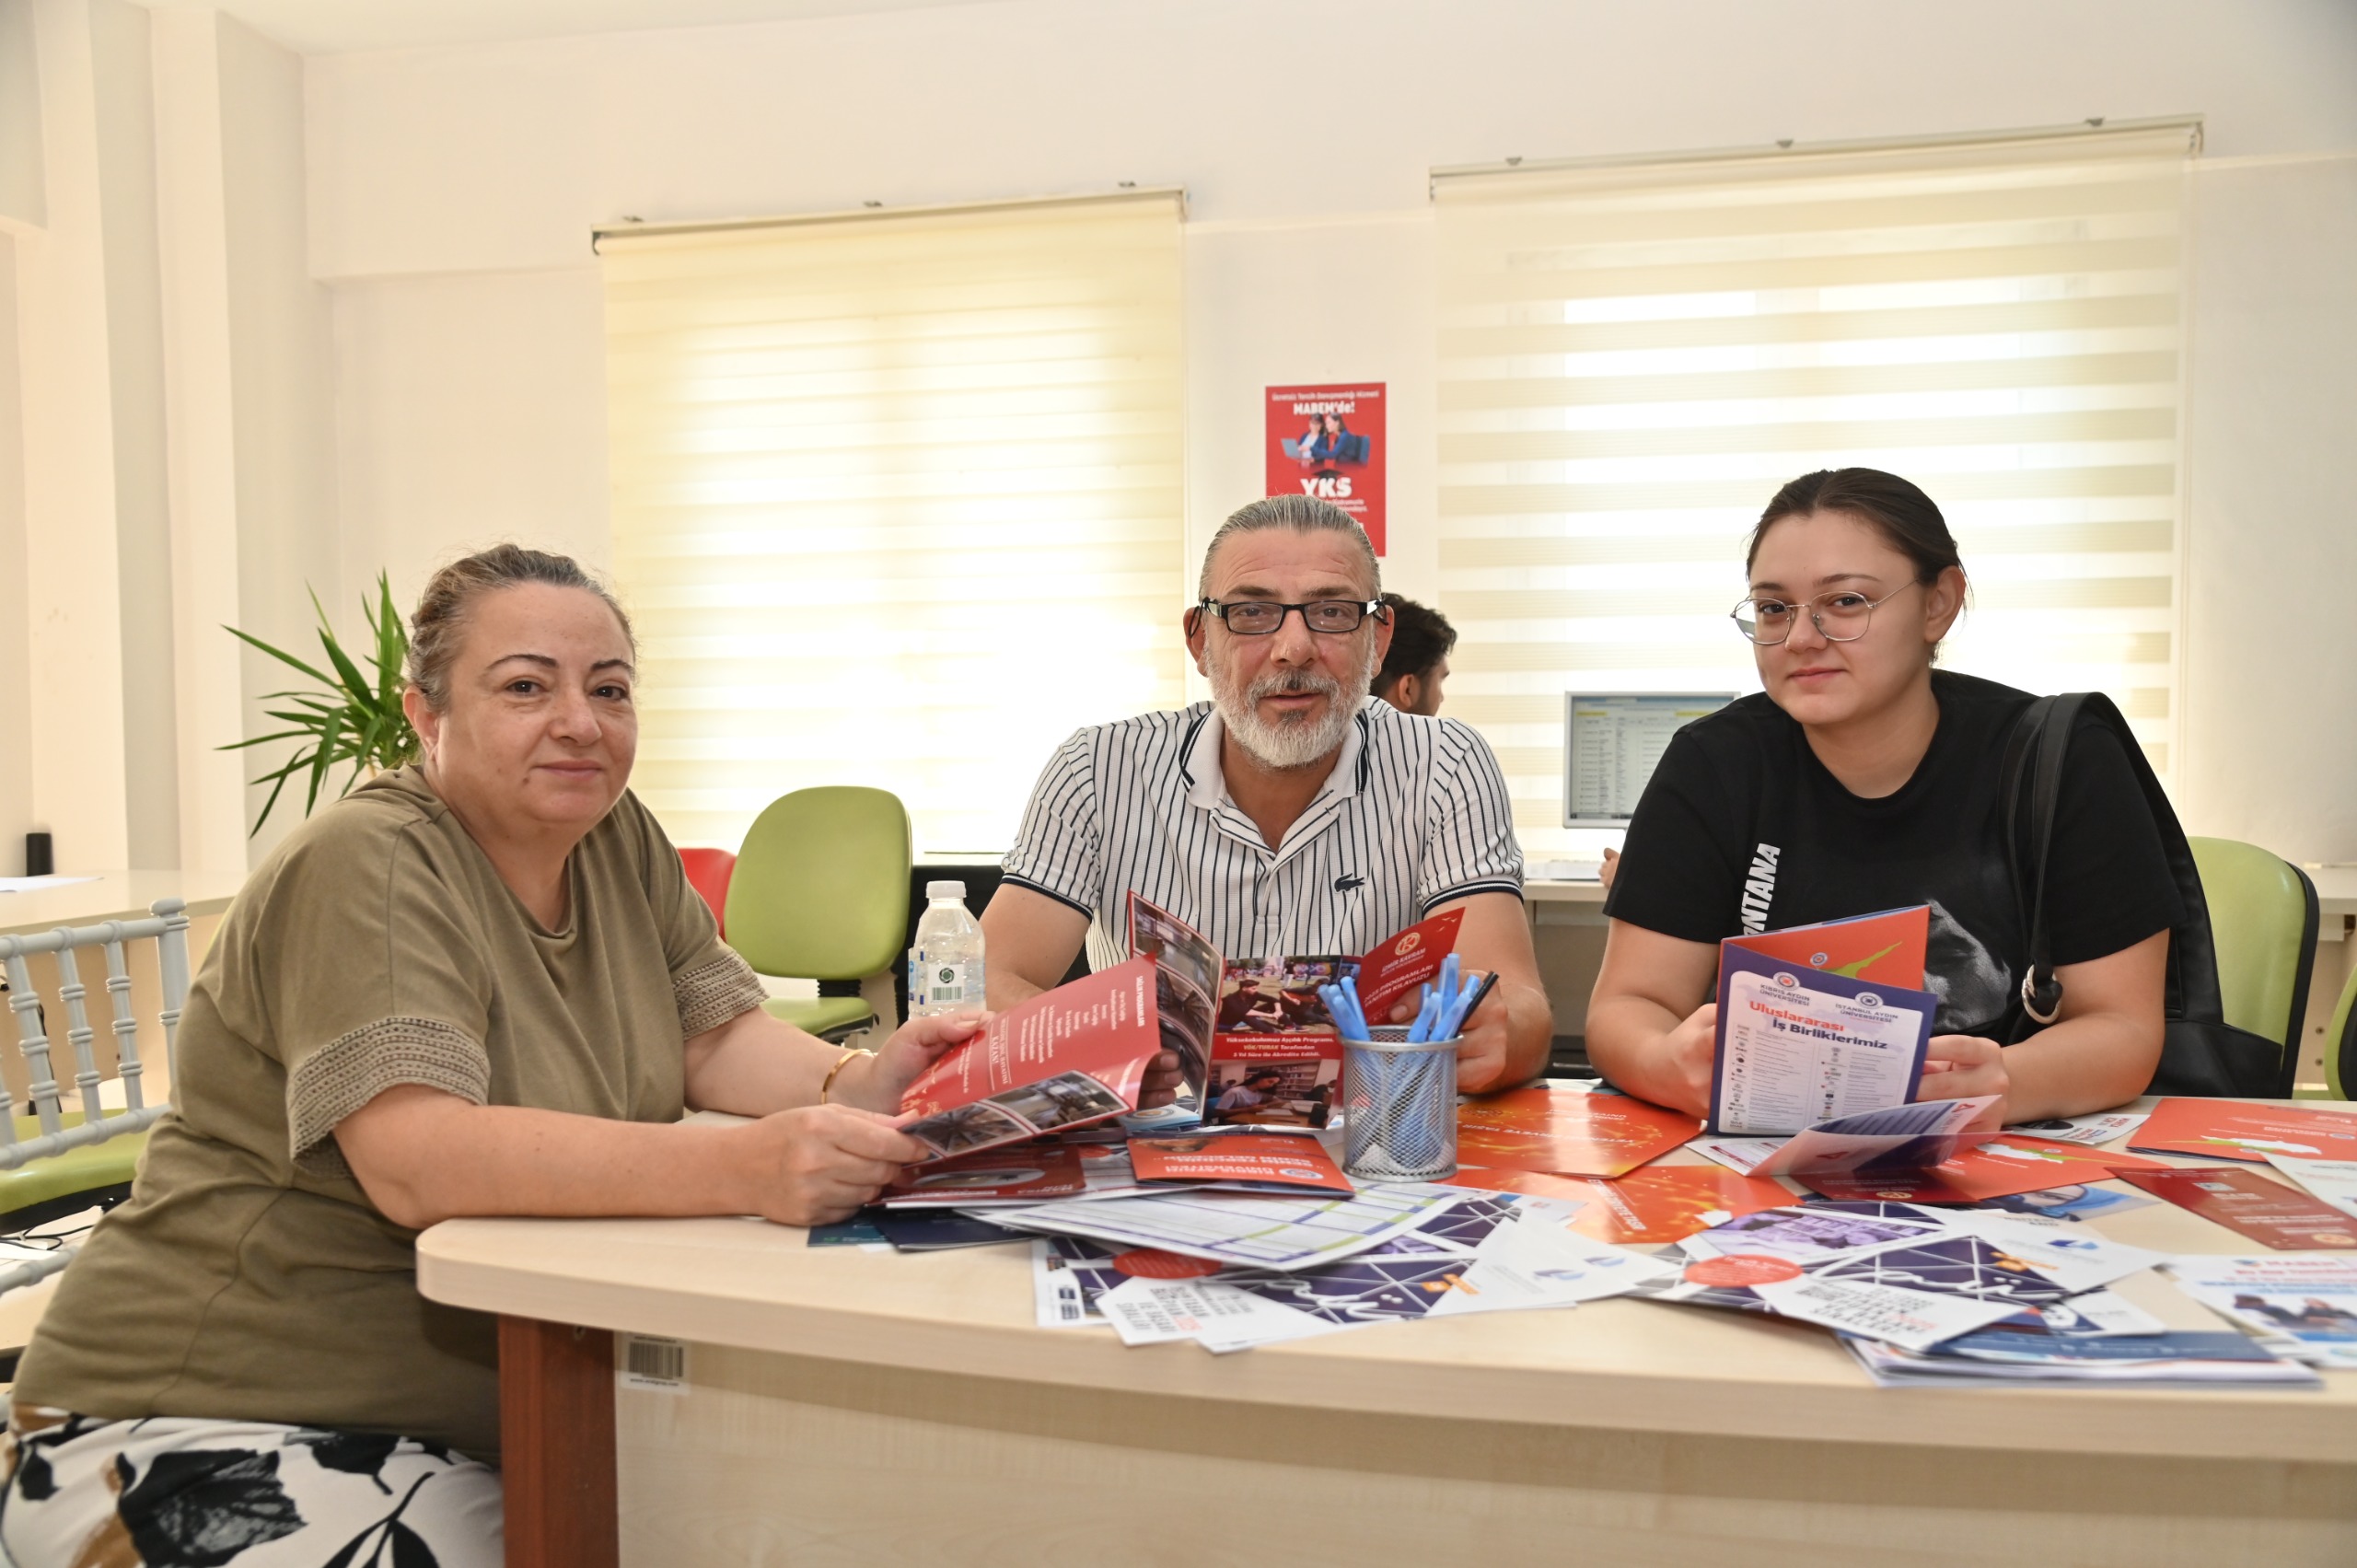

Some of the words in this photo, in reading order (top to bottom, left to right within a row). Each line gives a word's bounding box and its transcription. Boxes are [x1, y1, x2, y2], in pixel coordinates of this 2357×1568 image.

[1299, 477, 1353, 498] YKS
[1759, 989, 1810, 1006] ÜNİVERSİTESİ
[1760, 984, 1785, 996] KIBRIS
[1786, 990, 1810, 1002] AYDIN
[1749, 1000, 1844, 1031] Uluslararası
[1835, 1004, 1873, 1015] İSTANBUL
[1874, 1011, 1898, 1019] AYDIN
[1772, 1017, 1786, 1031] İş
[1790, 1023, 1888, 1050] Birliklerimiz
